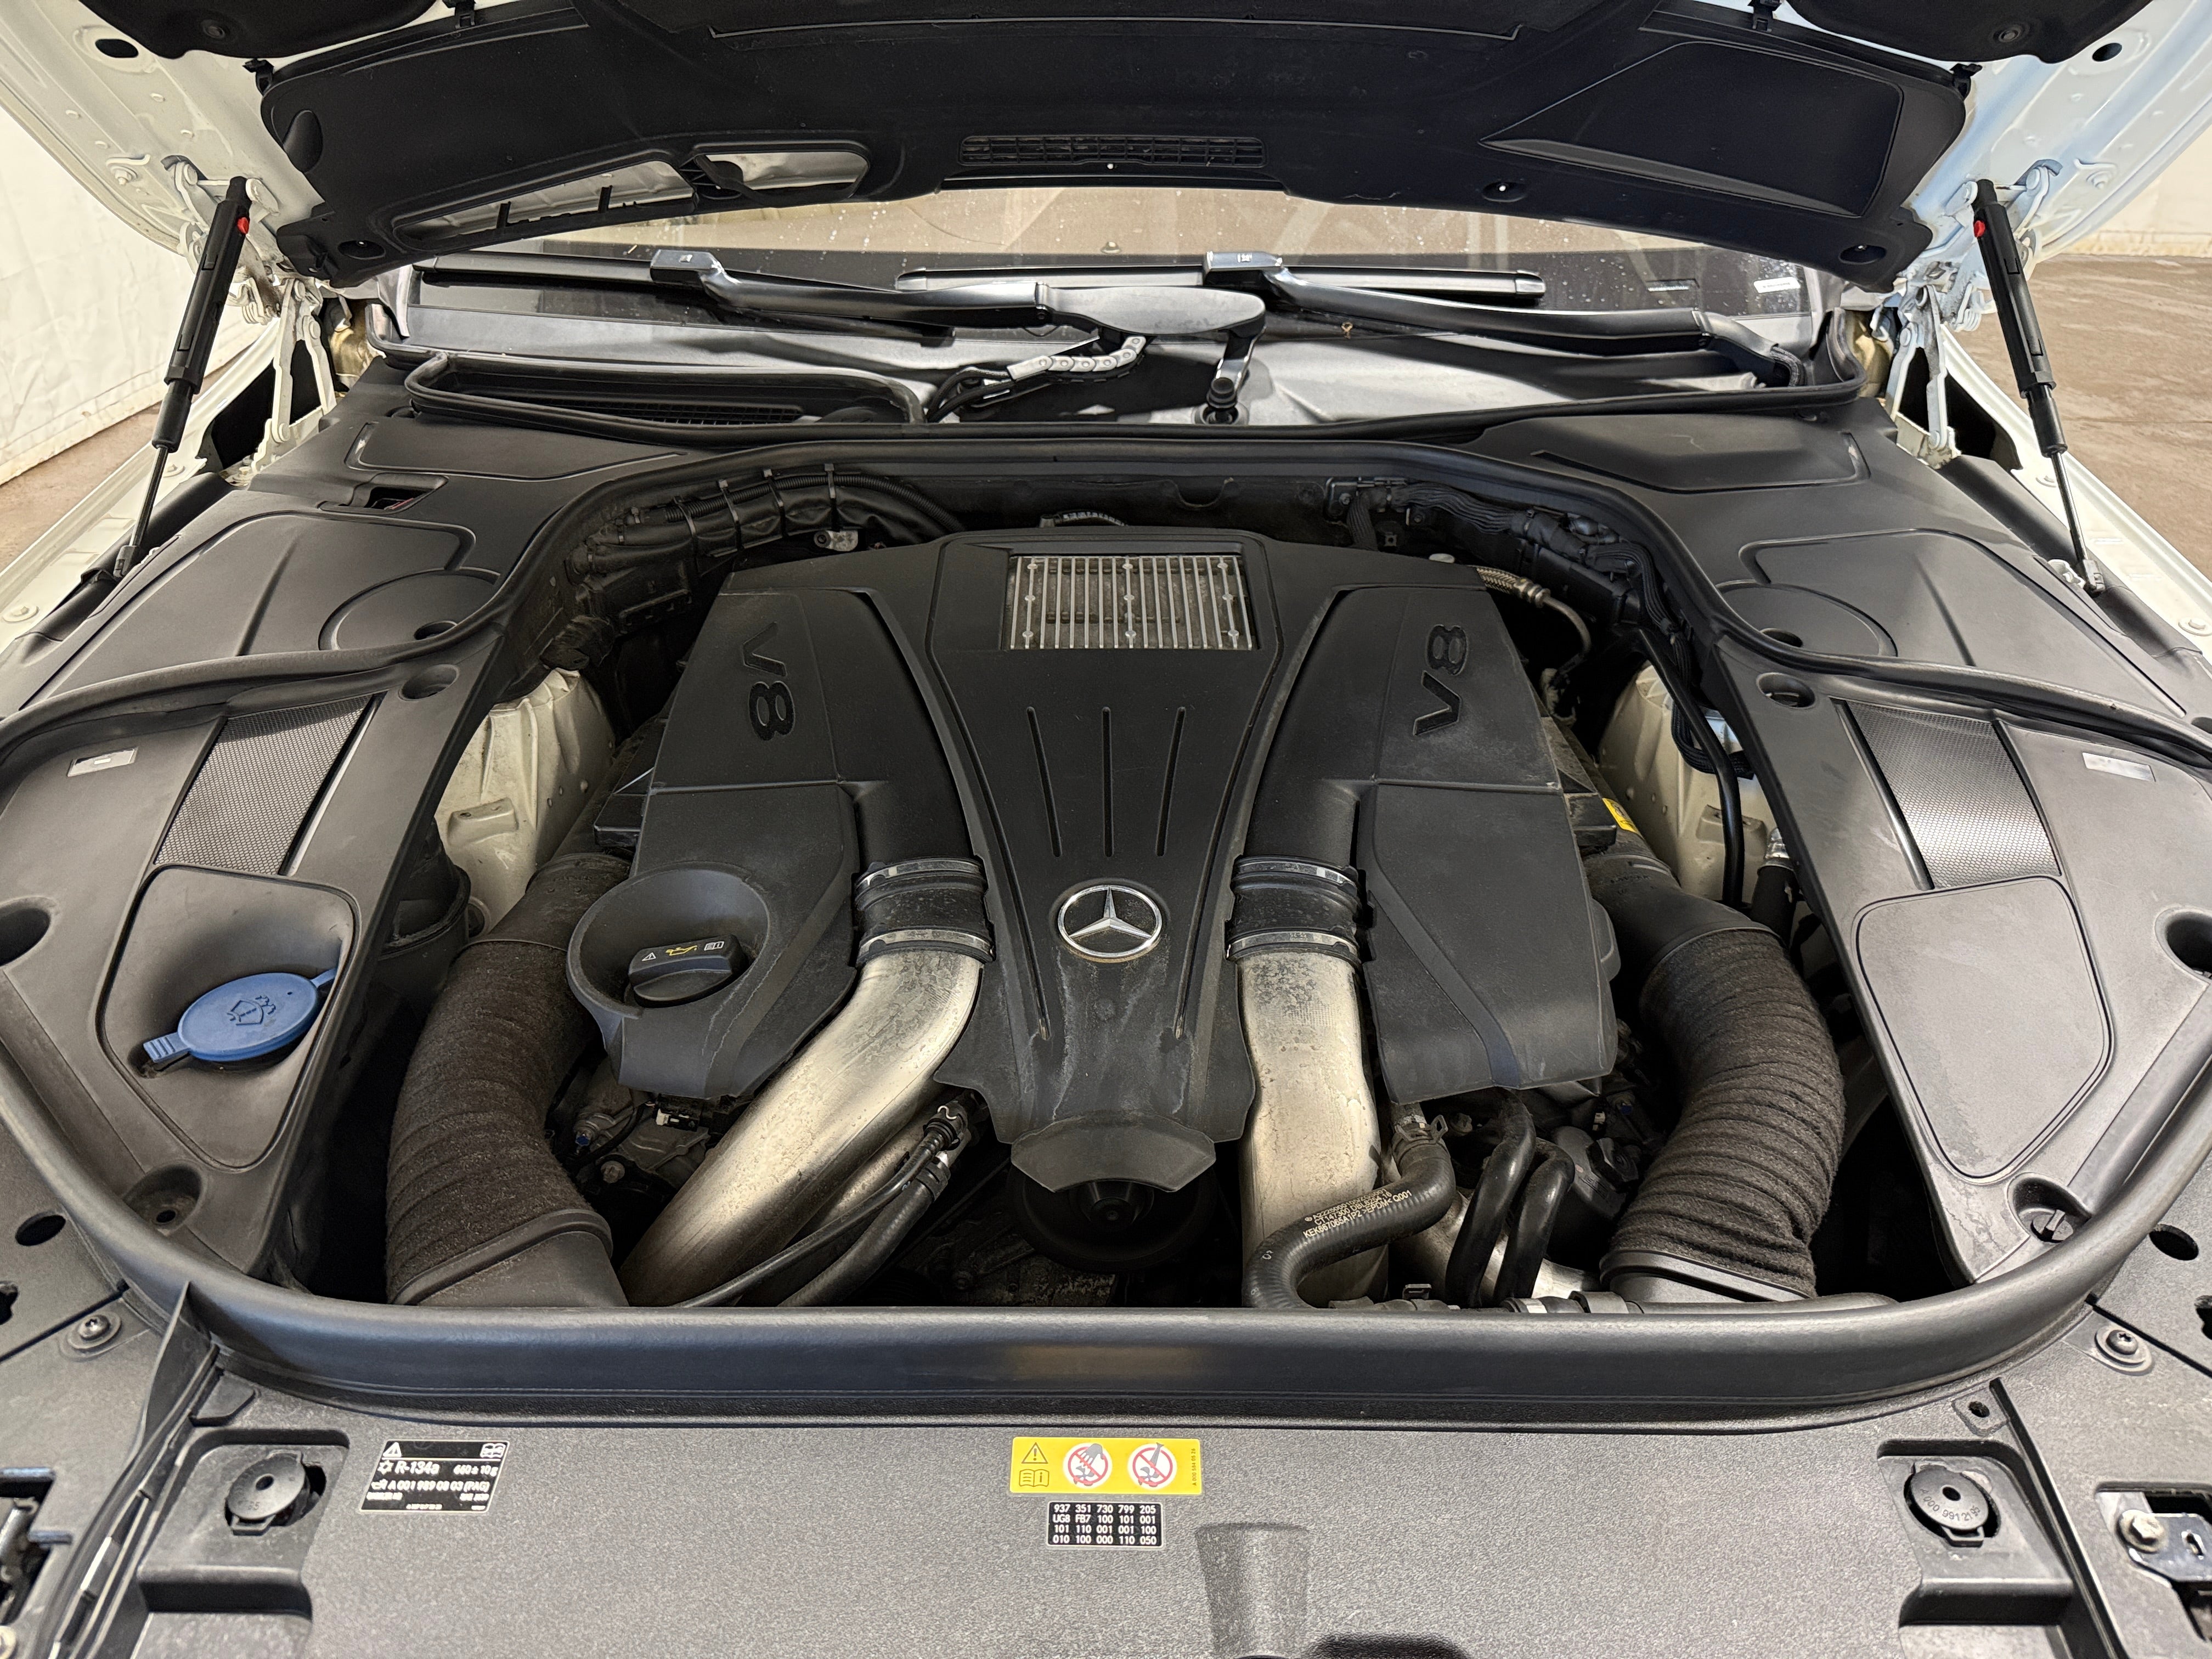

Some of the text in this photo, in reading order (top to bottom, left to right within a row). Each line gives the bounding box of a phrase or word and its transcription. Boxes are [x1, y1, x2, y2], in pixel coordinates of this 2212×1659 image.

[742, 621, 795, 741] V8
[1413, 624, 1468, 736] V8
[1392, 1189, 1412, 1202] Q001
[394, 1460, 440, 1475] R-134a
[387, 1480, 396, 1491] A
[463, 1481, 490, 1493] (PAG)
[1054, 1504, 1156, 1514] 937 351 730 799 205
[1053, 1514, 1071, 1523] UG8
[1098, 1514, 1114, 1524] 100
[1119, 1515, 1135, 1524] 101
[1139, 1515, 1156, 1525] 001
[1054, 1524, 1157, 1535] 101 110 001 001 100
[1053, 1534, 1157, 1545] 010 100 000 110 050
